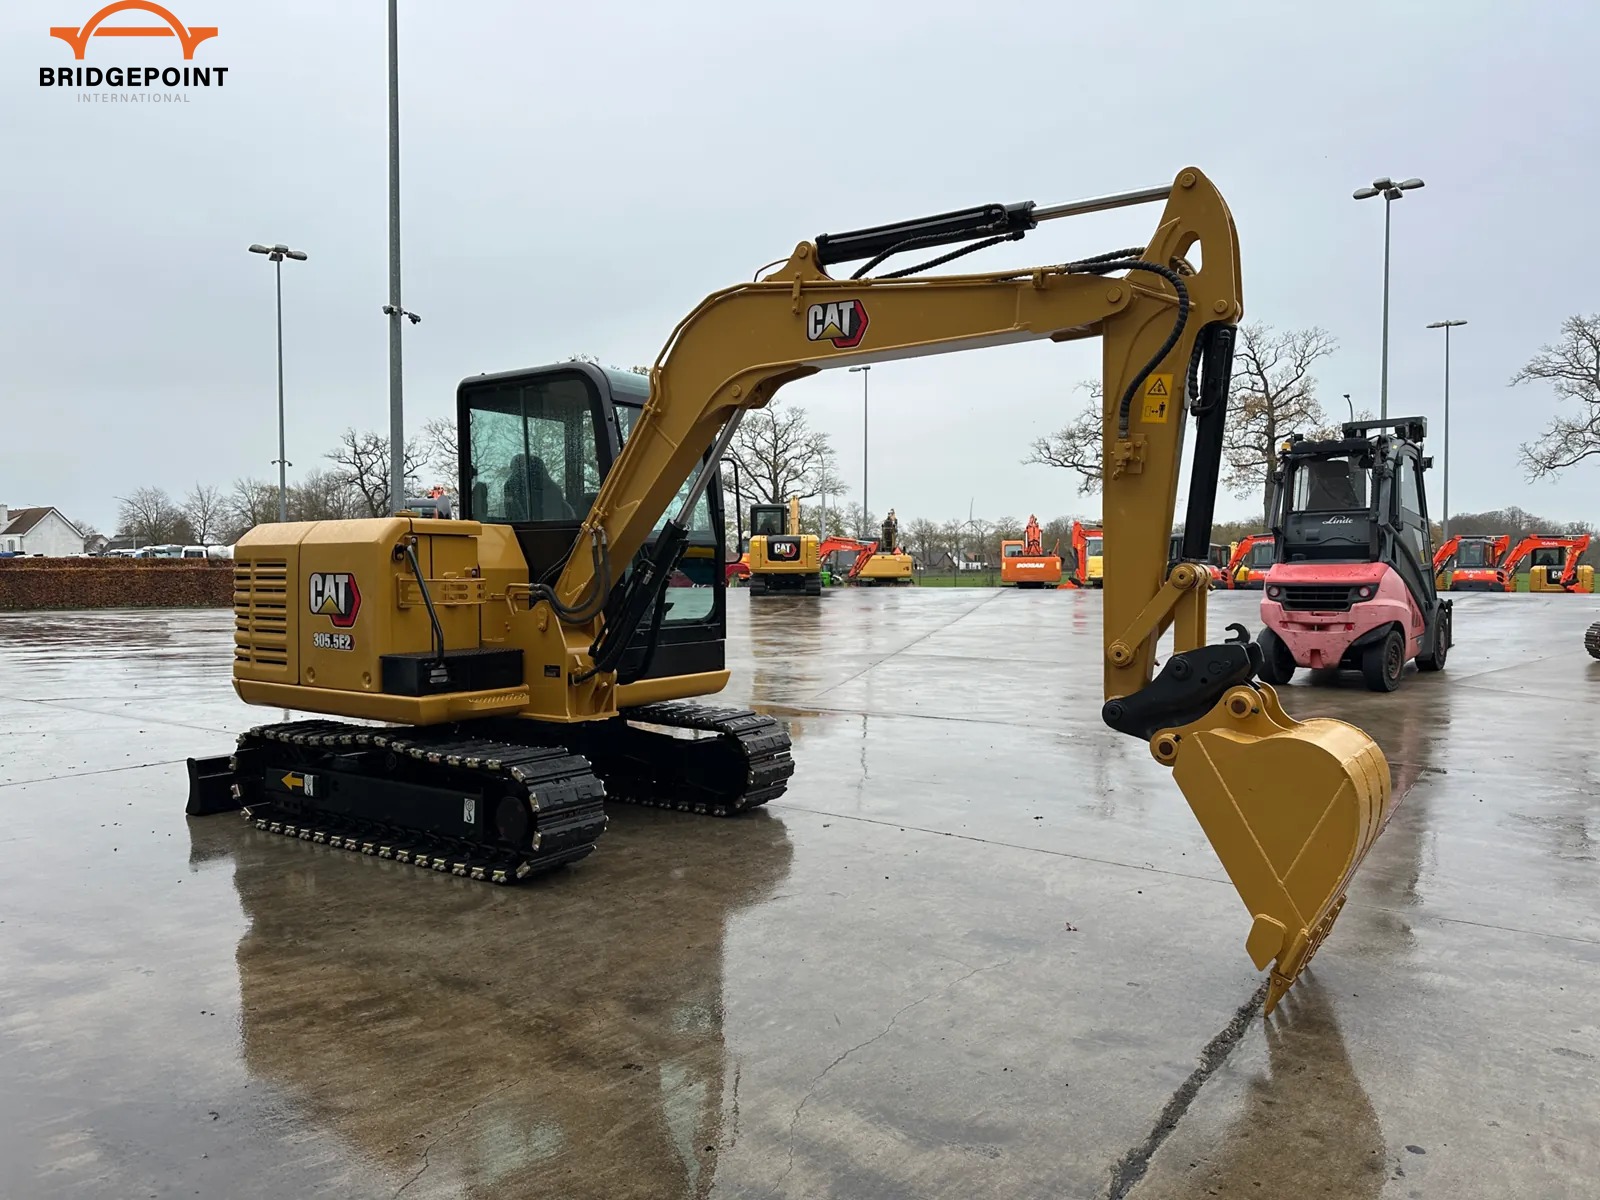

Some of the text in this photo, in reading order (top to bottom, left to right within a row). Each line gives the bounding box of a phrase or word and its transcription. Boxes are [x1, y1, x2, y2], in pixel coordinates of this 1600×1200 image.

[808, 301, 855, 340] CAT
[1321, 515, 1354, 525] Linde
[774, 543, 791, 554] CAT
[1551, 570, 1563, 579] CA
[310, 573, 349, 614] CAT
[313, 632, 351, 650] 305.5E2
